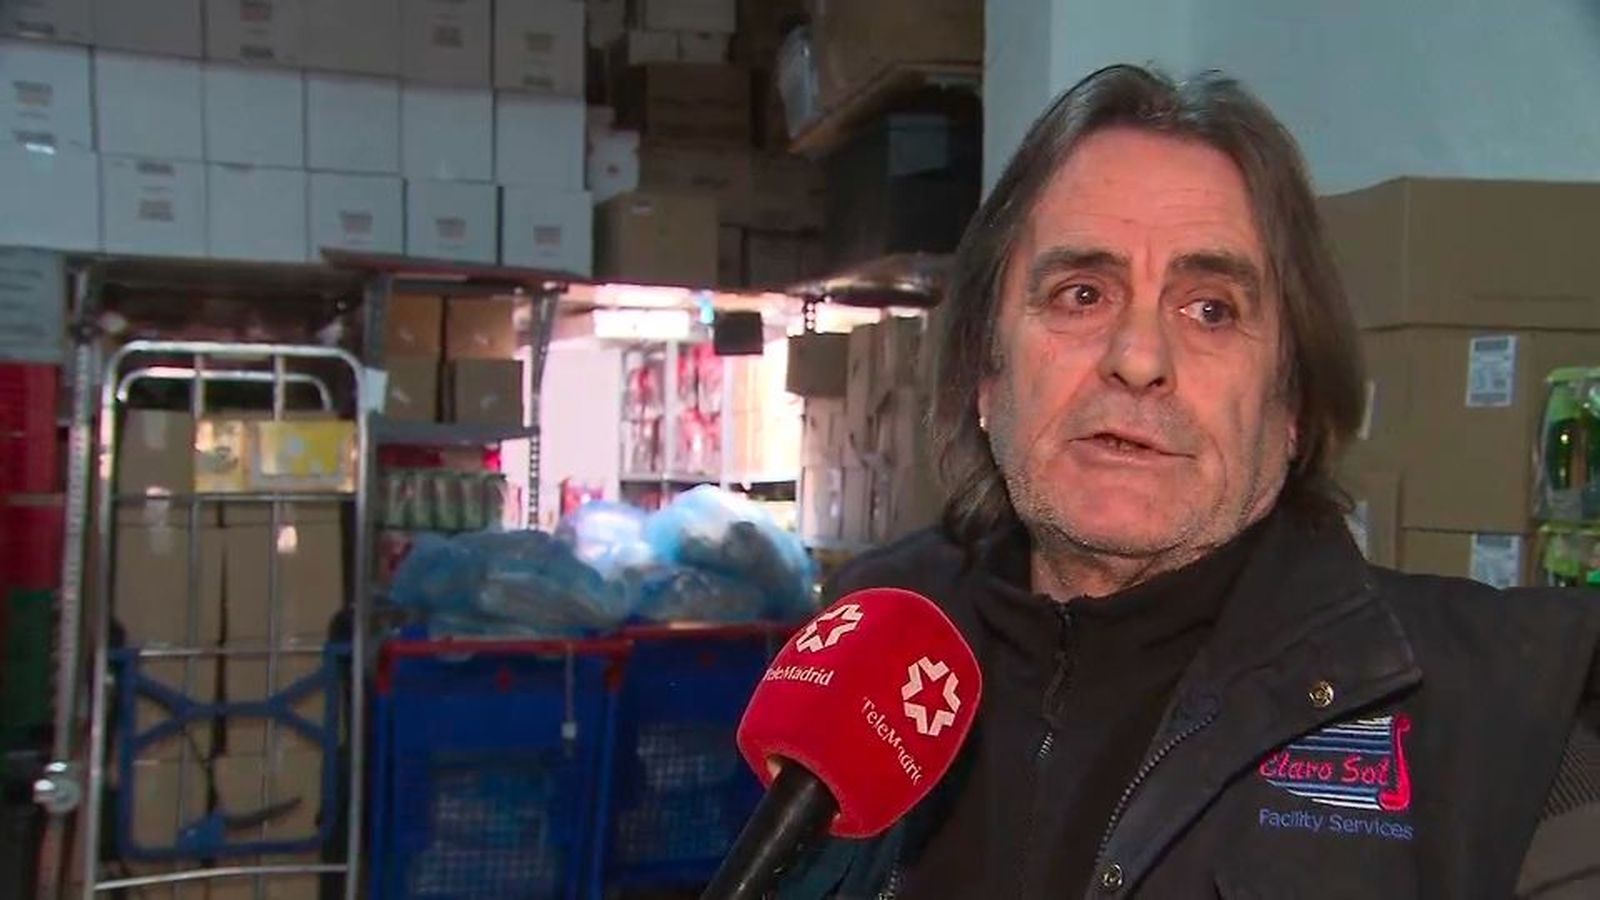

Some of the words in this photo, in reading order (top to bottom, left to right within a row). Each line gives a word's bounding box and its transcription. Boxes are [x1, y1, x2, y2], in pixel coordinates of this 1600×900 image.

[1259, 750, 1333, 780] Claro
[1341, 754, 1390, 785] Sol
[1259, 808, 1324, 832] Facility
[1330, 813, 1414, 840] Services
